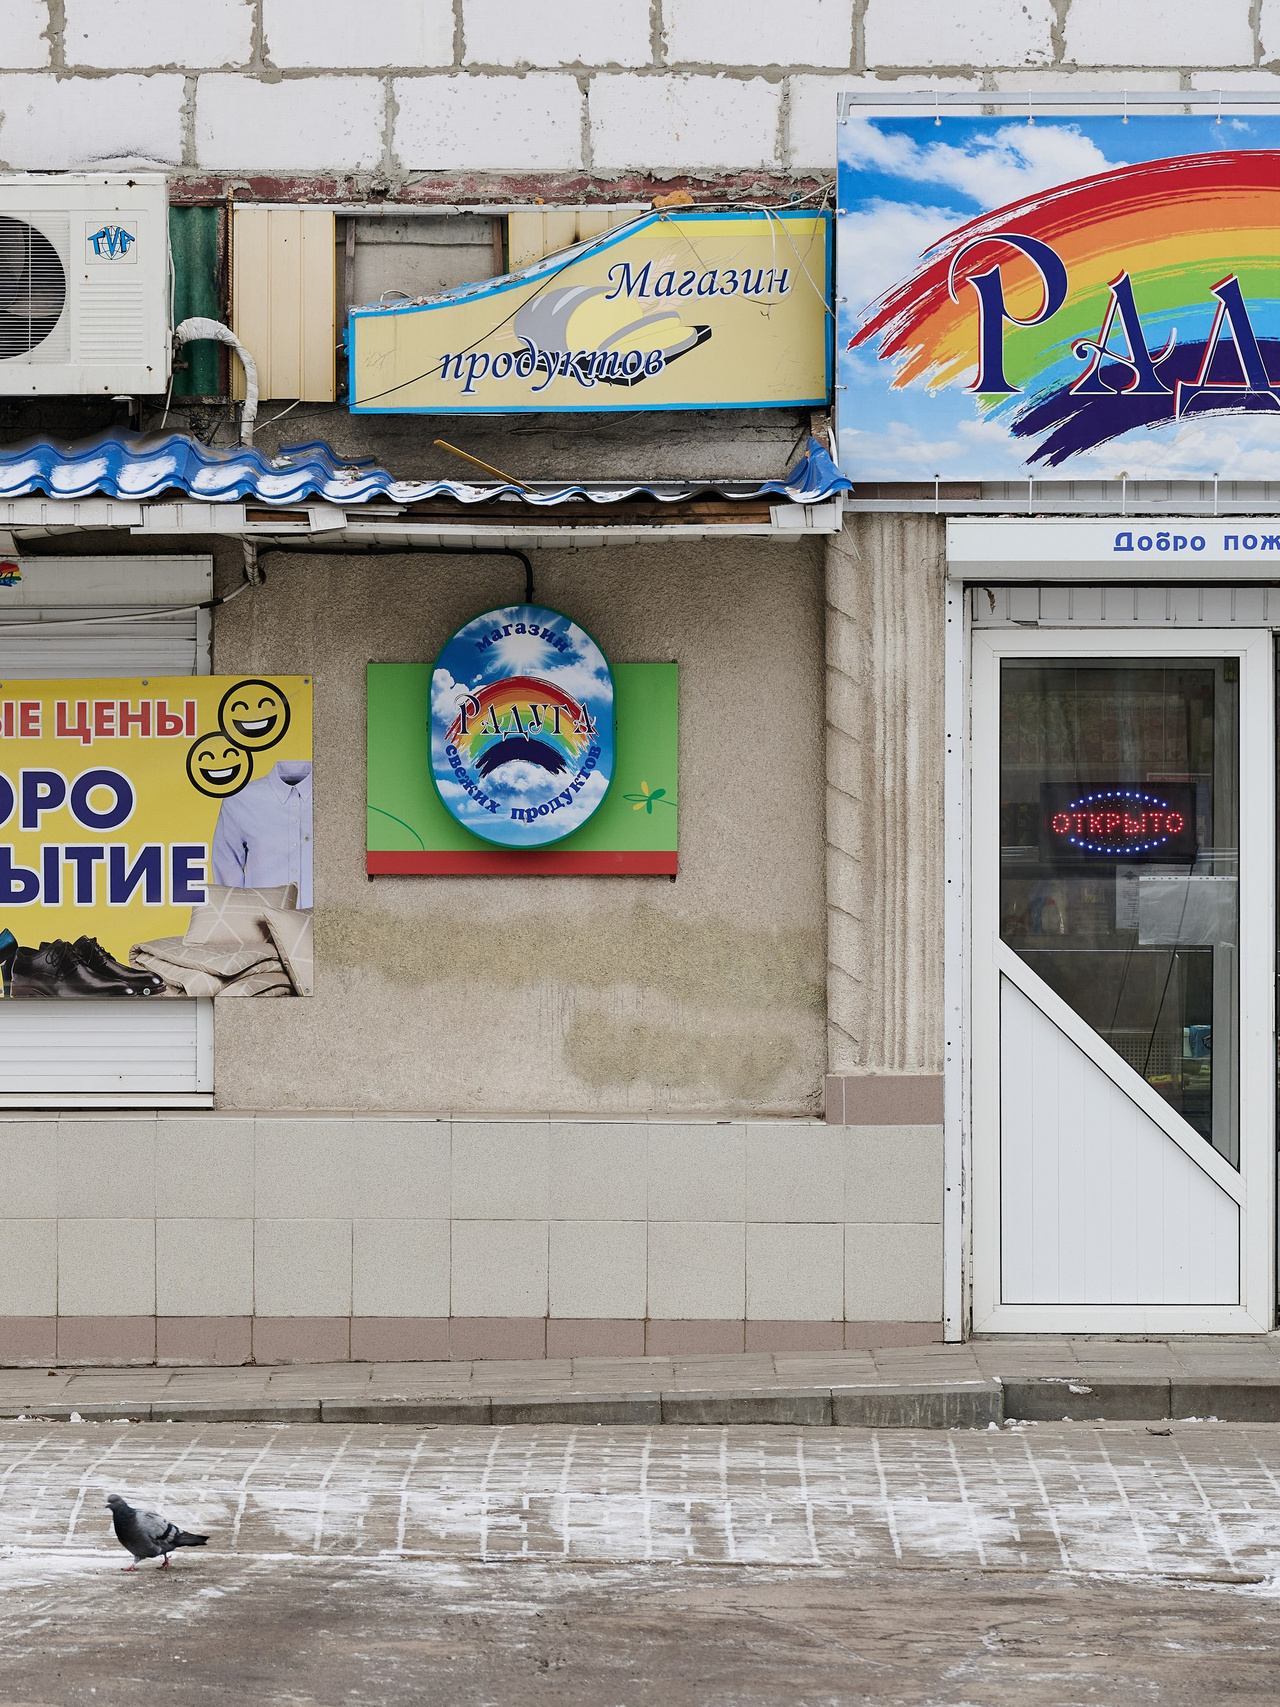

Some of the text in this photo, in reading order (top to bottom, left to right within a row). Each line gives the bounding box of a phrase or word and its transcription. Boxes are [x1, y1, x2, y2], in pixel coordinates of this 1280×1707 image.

[605, 261, 791, 300] Магазин
[439, 336, 666, 396] продуктов
[1113, 532, 1206, 552] Добро
[475, 622, 570, 653] магазин
[54, 699, 197, 746] ЦЕНЫ
[445, 744, 602, 823] свежих продуктов
[1051, 812, 1184, 834] ОТКРЫТО
